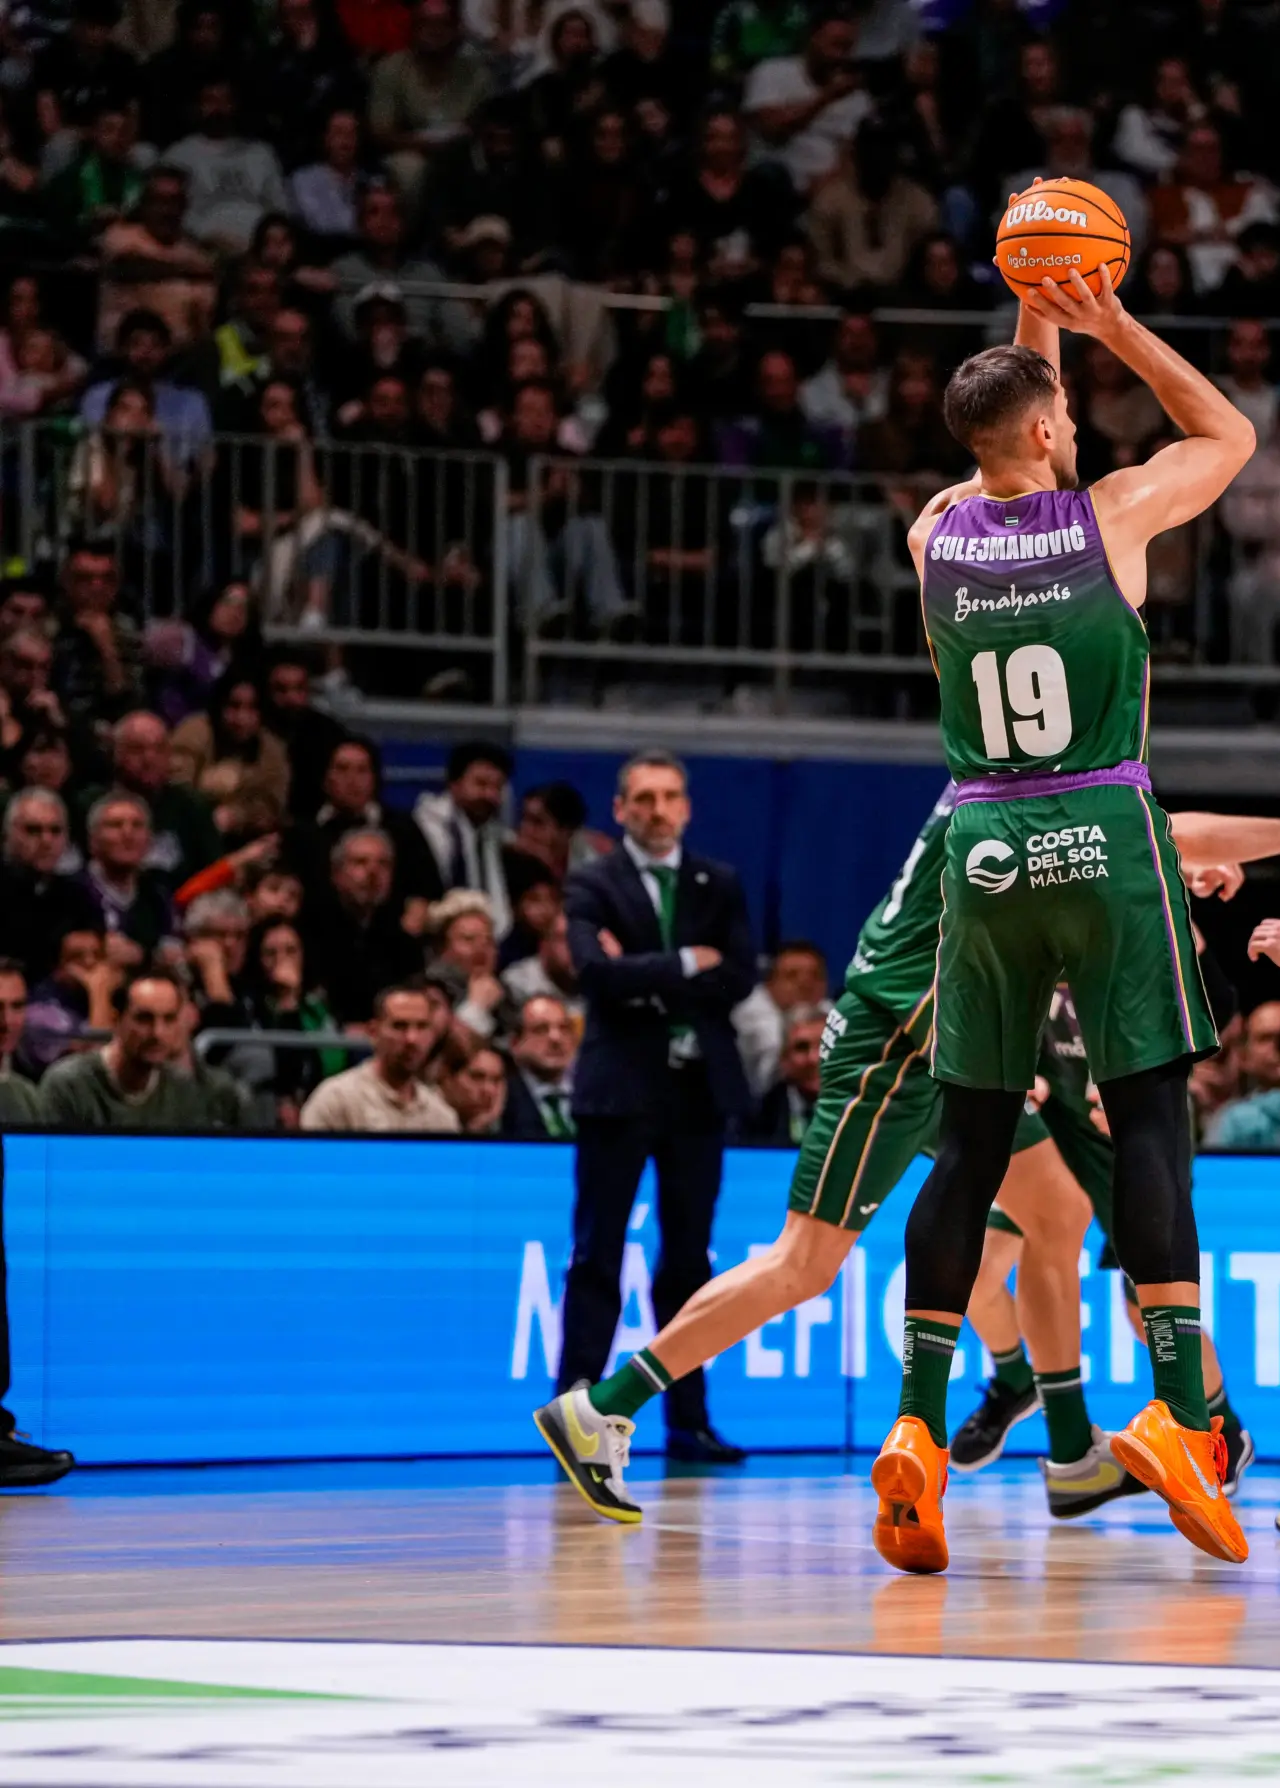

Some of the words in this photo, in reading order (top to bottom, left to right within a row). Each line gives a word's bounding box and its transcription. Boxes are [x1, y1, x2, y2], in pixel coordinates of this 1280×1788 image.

[1006, 200, 1087, 228] Wilson
[930, 520, 1086, 561] SULEJMANOVIĆ
[971, 644, 1073, 760] 19
[1026, 825, 1107, 852] COSTA
[1027, 852, 1064, 872] DEL
[1067, 845, 1108, 864] SOL
[1029, 863, 1109, 889] MÁLAGA
[1150, 1319, 1177, 1362] UNICAJA
